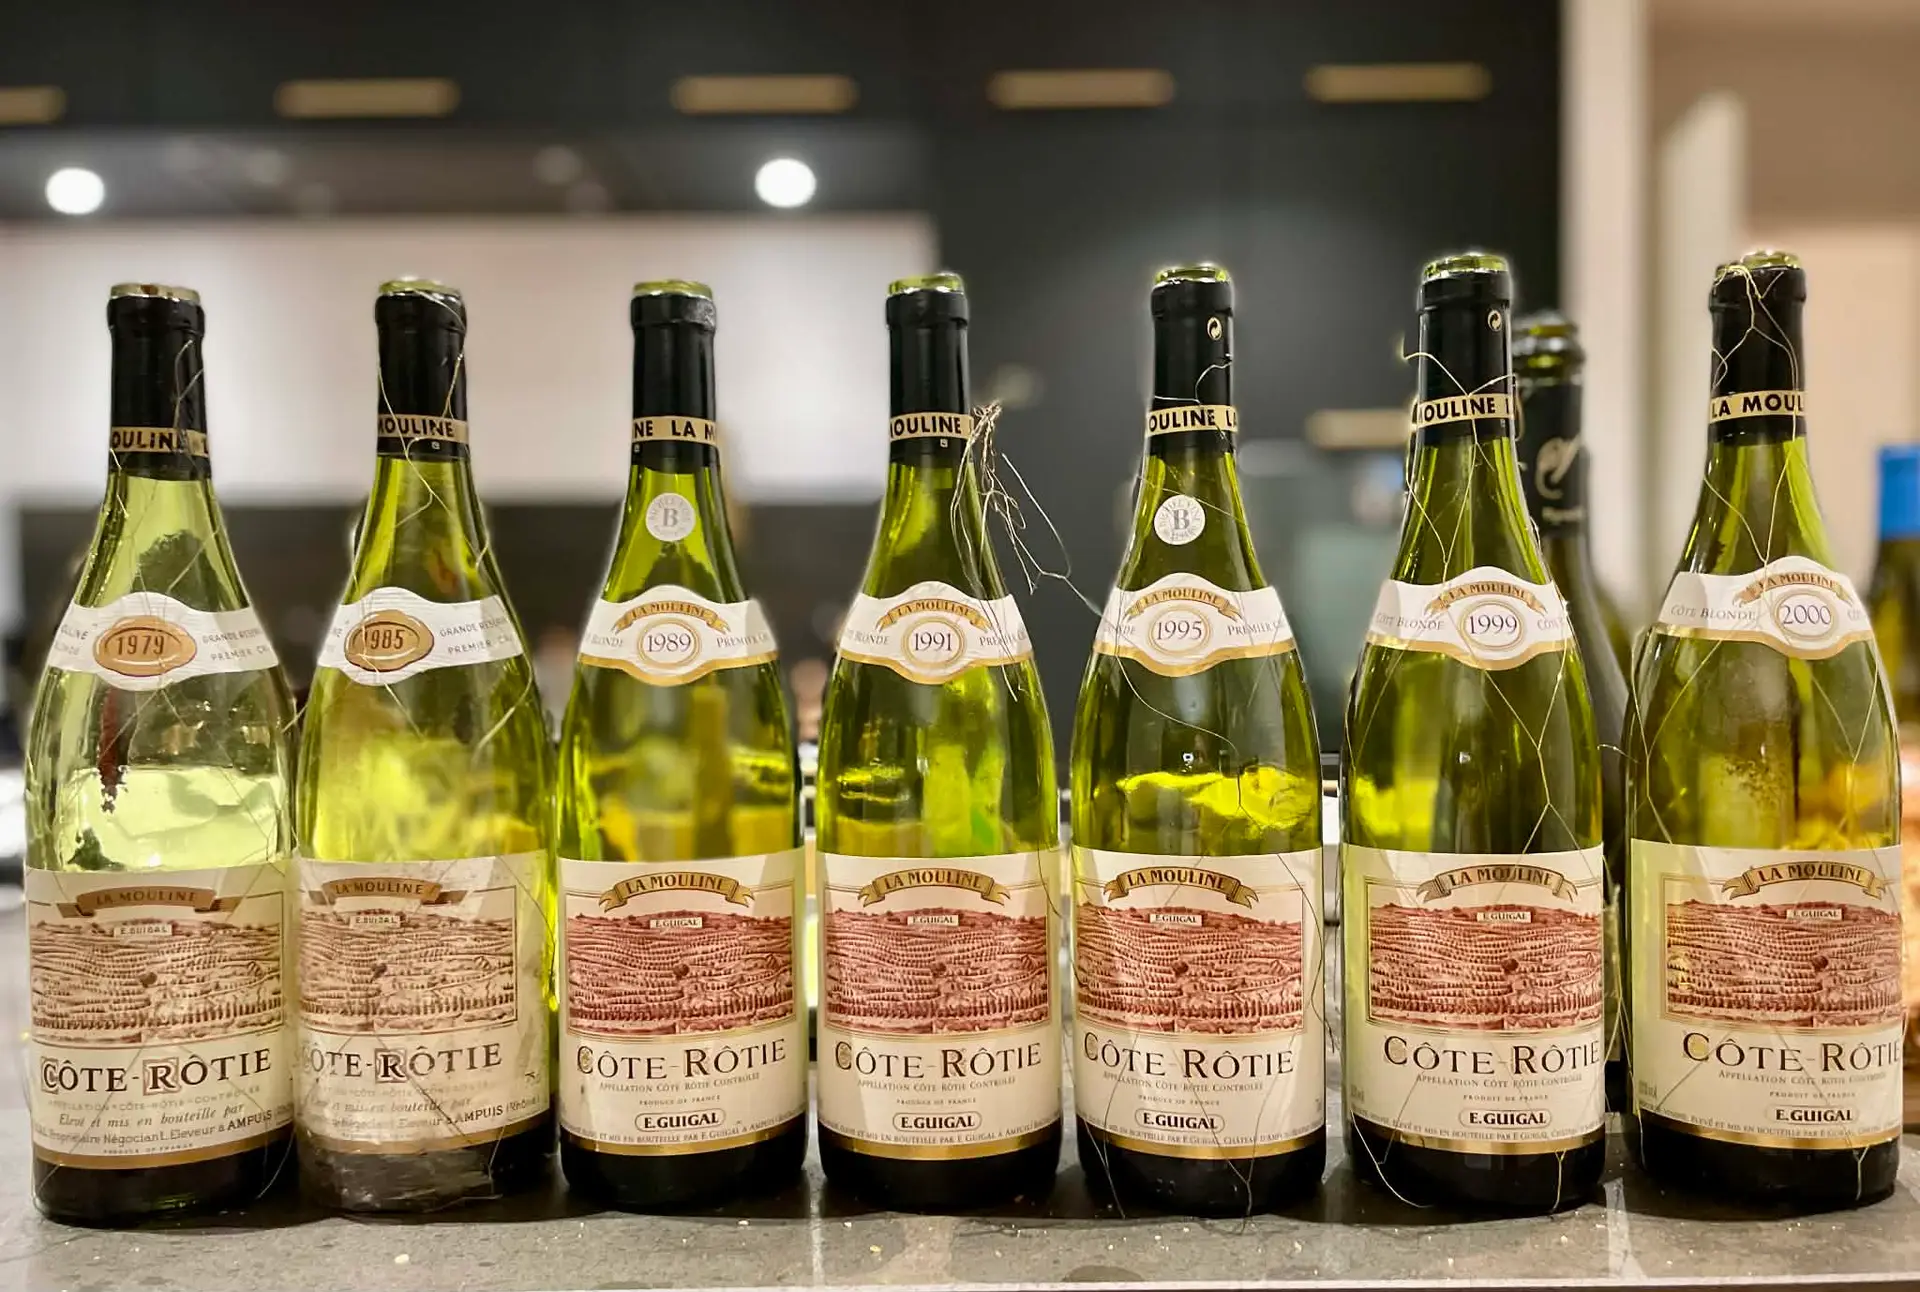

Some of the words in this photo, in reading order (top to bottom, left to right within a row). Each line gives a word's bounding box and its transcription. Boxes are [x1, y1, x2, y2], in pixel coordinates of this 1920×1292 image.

[1226, 409, 1237, 428] L
[1413, 397, 1496, 424] OULINE
[1712, 400, 1731, 418] LA
[671, 419, 696, 438] LA
[890, 415, 962, 439] OULINE
[663, 508, 679, 527] B
[1173, 509, 1190, 530] B
[1783, 604, 1831, 625] 2000
[1157, 619, 1202, 641] 1995
[1470, 614, 1517, 635] 1999
[117, 635, 165, 656] 1979
[647, 632, 692, 653] 1989
[914, 630, 952, 652] 1991
[885, 874, 904, 891] LA
[908, 871, 981, 889] MOULINE
[1127, 873, 1147, 887] LA
[1151, 868, 1225, 890] MOULINE
[1449, 872, 1472, 887] LA
[1477, 867, 1554, 886] MOULINE
[1758, 866, 1783, 882] LA
[1788, 863, 1863, 882] MOULINE
[353, 881, 424, 895] MOULINE
[625, 878, 646, 895] LA
[651, 876, 723, 890] MOULINE
[119, 889, 196, 903] MOULINE
[644, 1111, 719, 1129] E.GUIGAL
[901, 1115, 975, 1129] E.GUIGAL
[1143, 1112, 1217, 1130] E.GUIGAL
[1469, 1112, 1547, 1126] E.GUIGAL
[1775, 1109, 1853, 1122] E.GUIGAL
